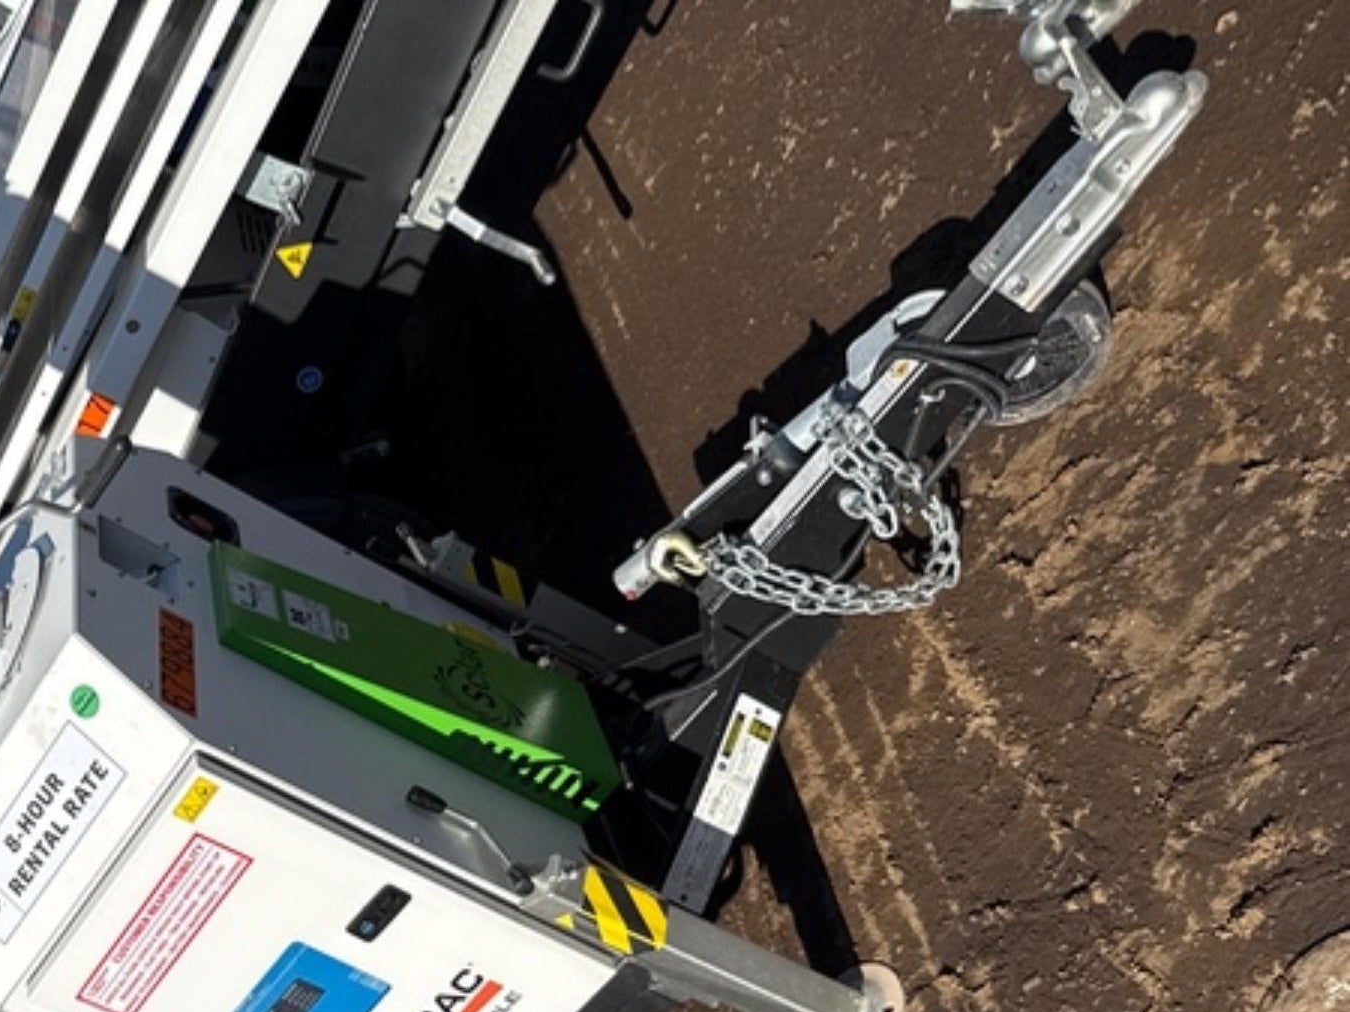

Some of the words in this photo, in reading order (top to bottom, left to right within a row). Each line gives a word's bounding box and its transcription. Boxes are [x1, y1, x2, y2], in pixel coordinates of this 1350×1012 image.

[4, 773, 65, 853] 8-HOUR
[8, 821, 70, 898] RENTAL
[62, 759, 109, 819] RATE
